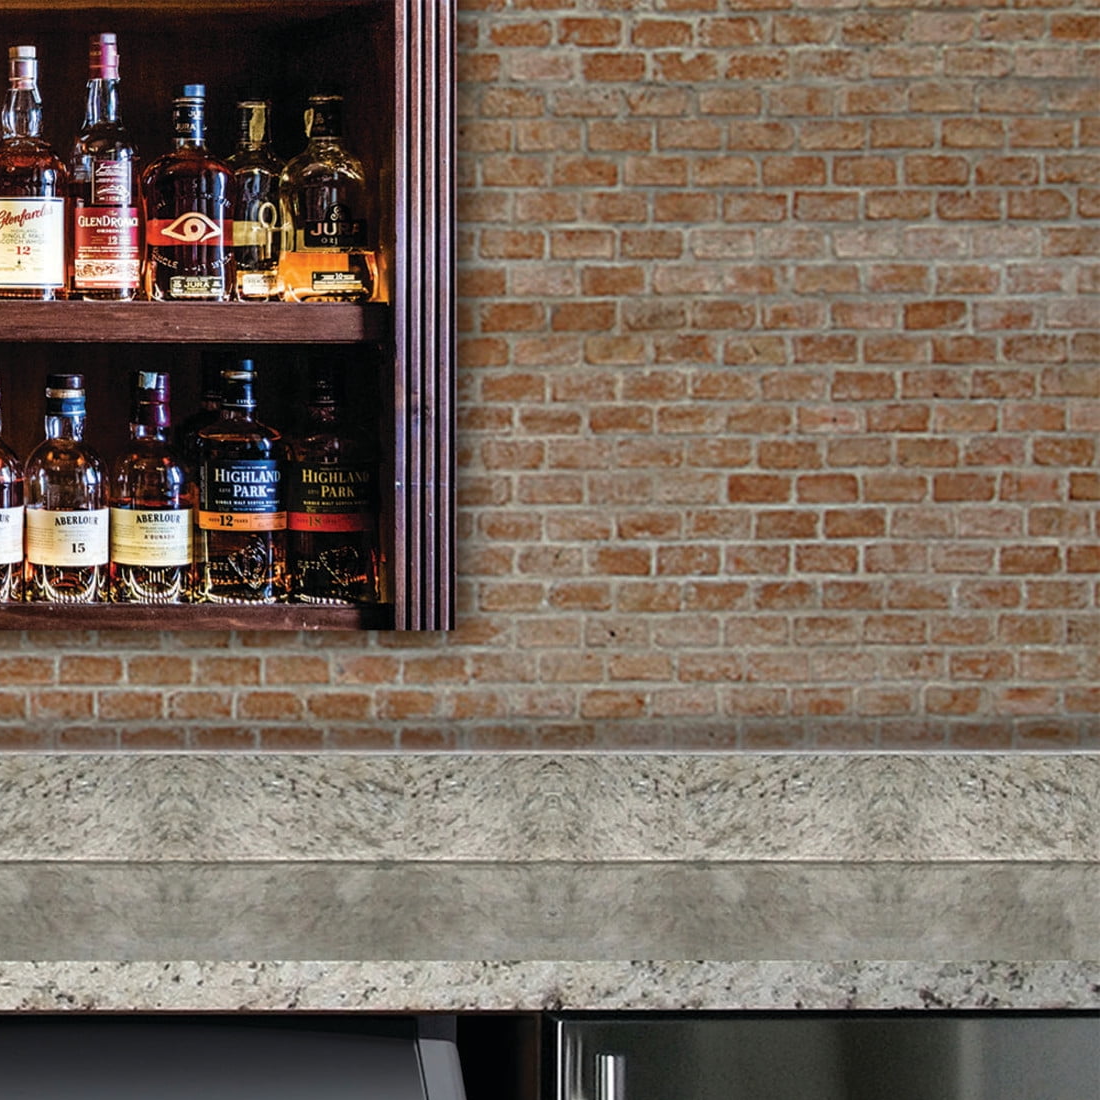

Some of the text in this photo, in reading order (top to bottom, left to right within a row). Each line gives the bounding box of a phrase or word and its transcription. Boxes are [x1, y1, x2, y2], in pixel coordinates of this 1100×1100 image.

[108, 236, 118, 245] 12
[16, 246, 31, 255] 12
[183, 281, 209, 289] JURA
[214, 468, 281, 483] HIGHLAND
[302, 469, 369, 483] HIGHLAND
[233, 484, 268, 498] PARK
[321, 485, 355, 498] PARK
[54, 515, 99, 527] ABERLOUR
[135, 513, 181, 524] ABERLOUR
[219, 514, 234, 527] 12
[308, 515, 322, 527] 18
[71, 543, 86, 553] 15
